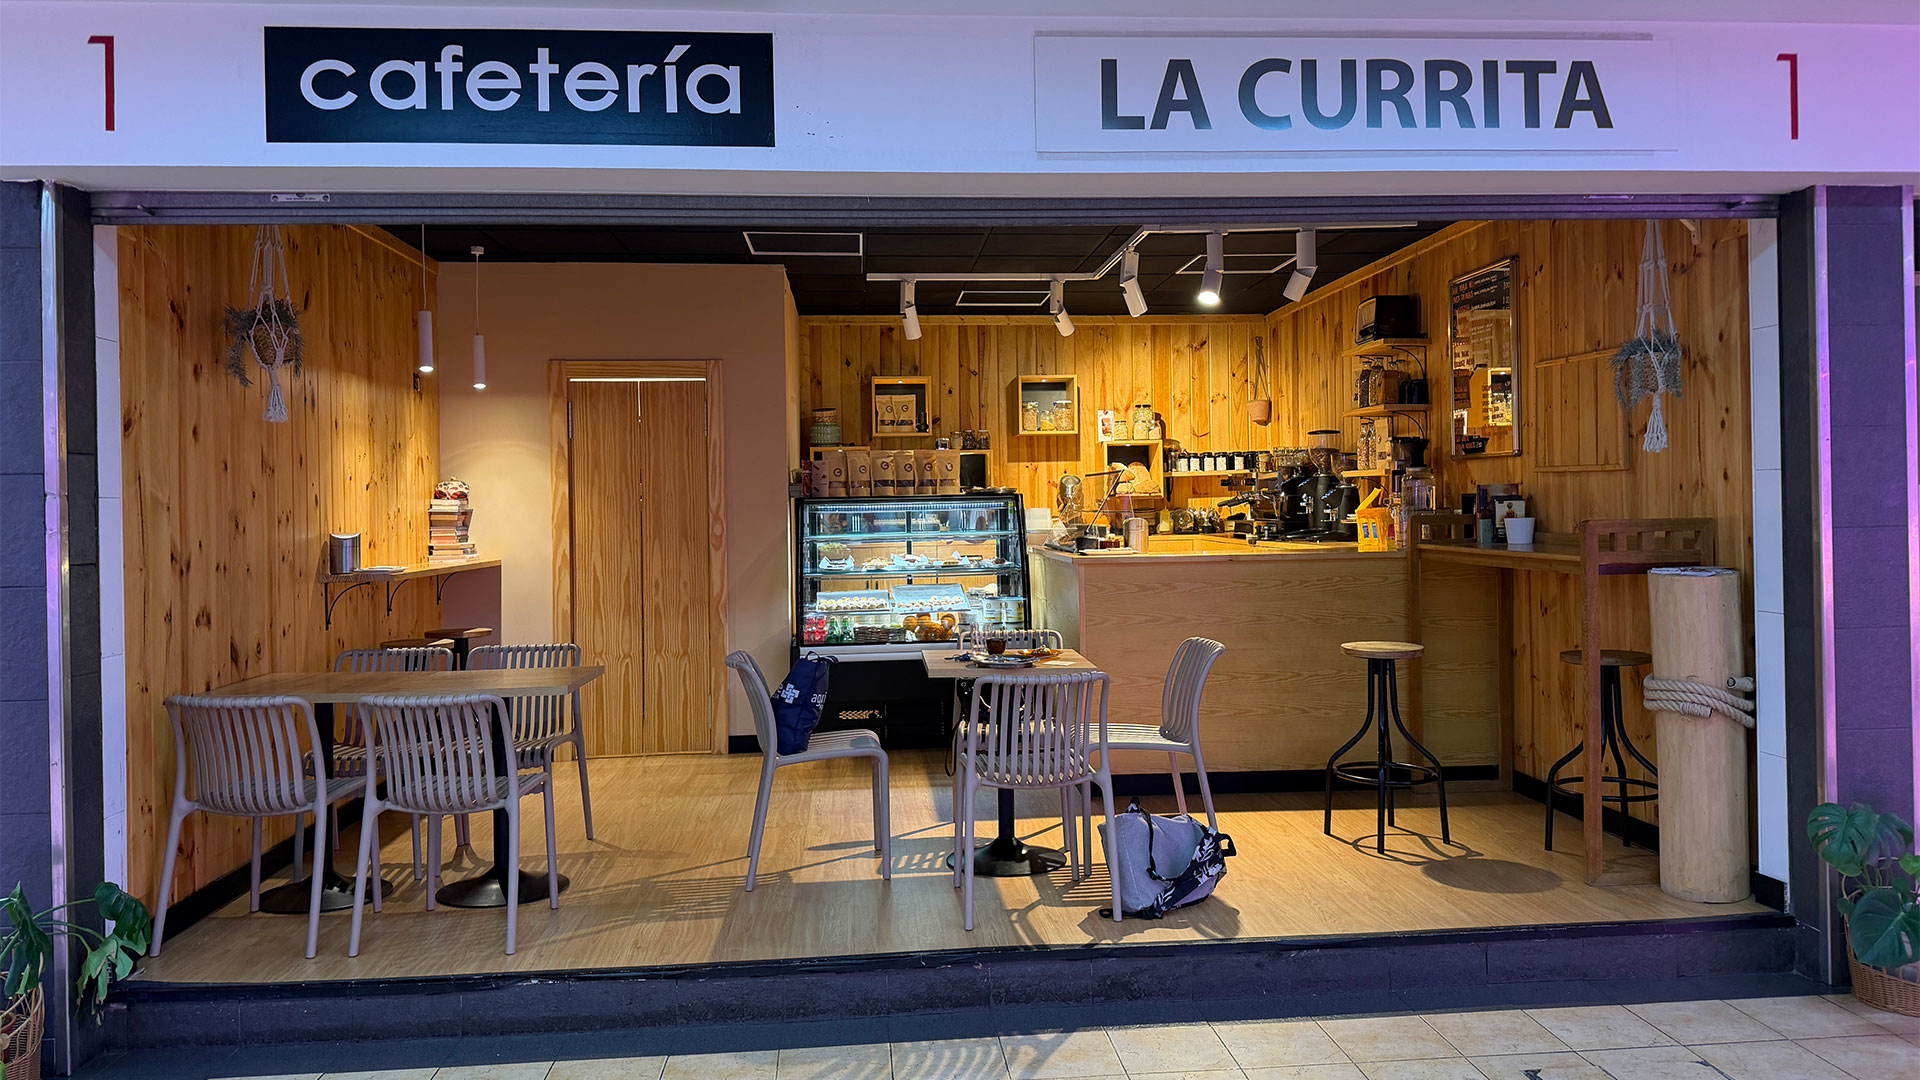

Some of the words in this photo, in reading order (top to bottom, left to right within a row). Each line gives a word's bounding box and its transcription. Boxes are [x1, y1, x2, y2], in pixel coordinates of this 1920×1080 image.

[87, 35, 116, 132] 1
[300, 44, 742, 115] cafetería
[1100, 58, 1213, 131] LA
[1237, 57, 1614, 130] CURRITA
[1776, 53, 1799, 140] 1
